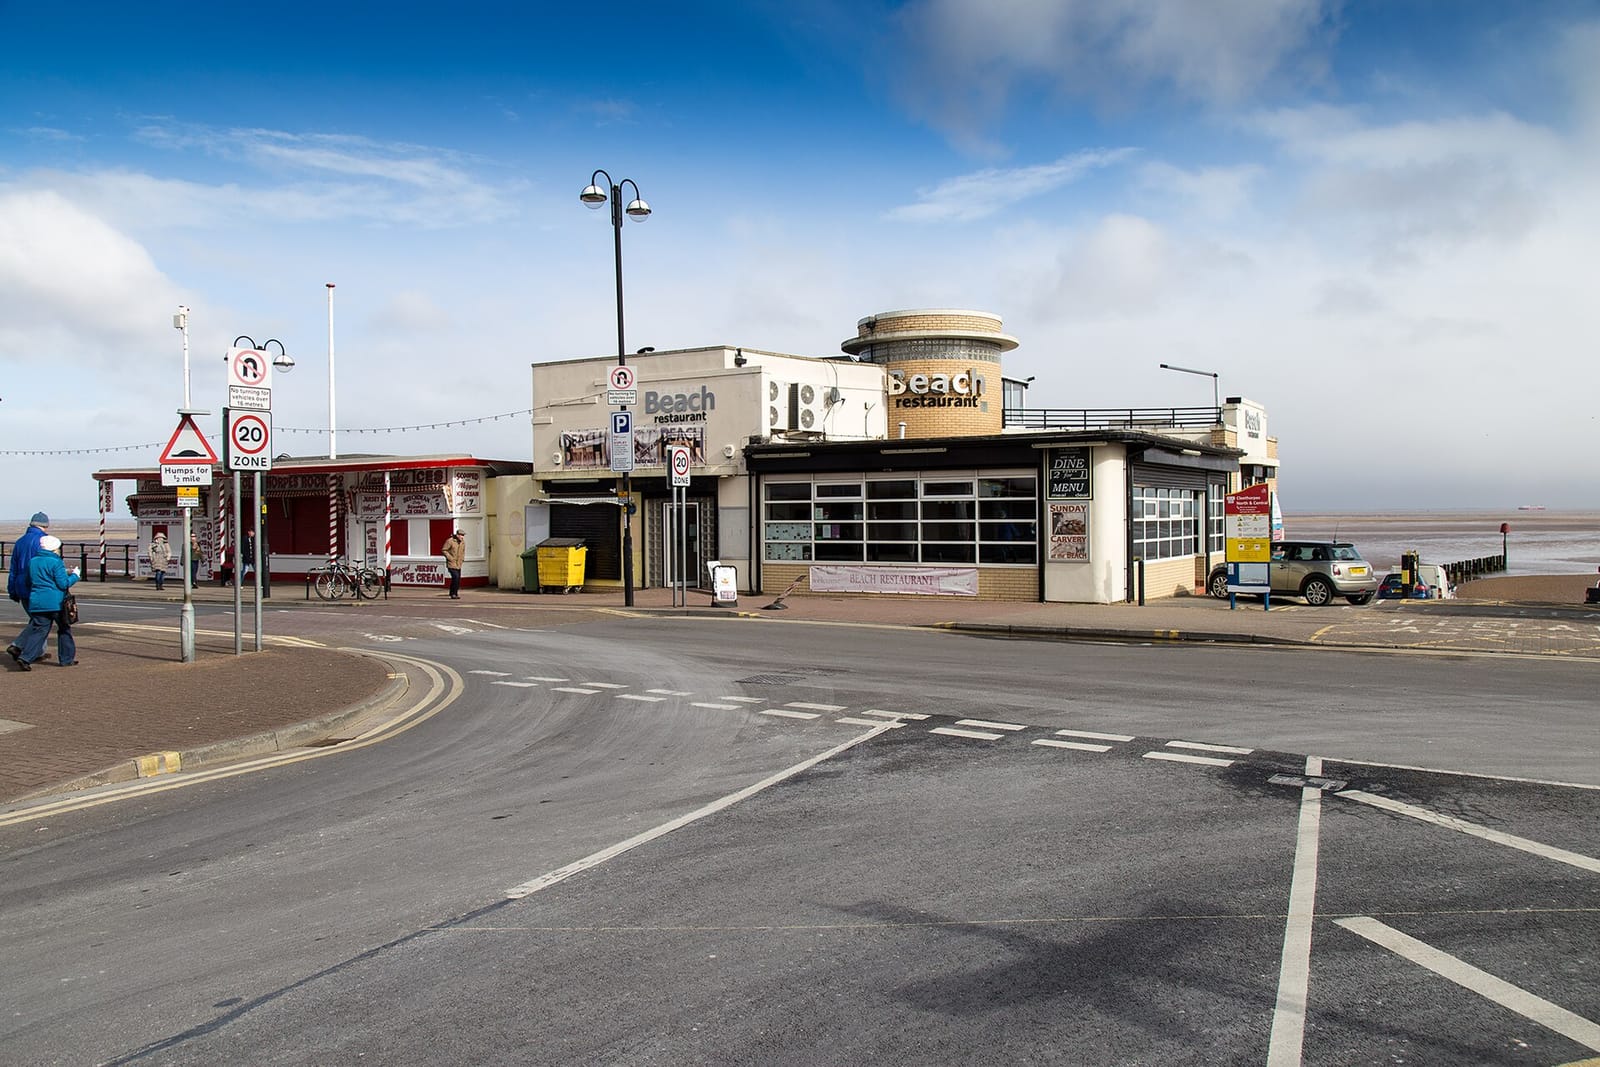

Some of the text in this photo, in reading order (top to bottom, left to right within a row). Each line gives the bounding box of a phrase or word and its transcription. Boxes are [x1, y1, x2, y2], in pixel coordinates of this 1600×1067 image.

[887, 367, 986, 396] Beach
[644, 385, 715, 414] Beach
[895, 395, 978, 408] restaurant
[654, 411, 707, 423] restaurant
[615, 415, 627, 432] P
[238, 426, 262, 442] 20
[234, 456, 268, 467] ZONE
[675, 456, 687, 468] 20
[1054, 458, 1085, 469] DINE
[673, 476, 689, 484] ZONE
[1052, 471, 1061, 479] 2
[1079, 470, 1085, 478] 1
[1052, 482, 1084, 492] MENU
[1050, 504, 1086, 512] SUNDAY
[1050, 535, 1087, 543] CARVERY
[415, 564, 438, 572] JERSEY
[402, 573, 444, 583] ICE CREAM
[849, 574, 934, 586] BEACH RESTAURANT
